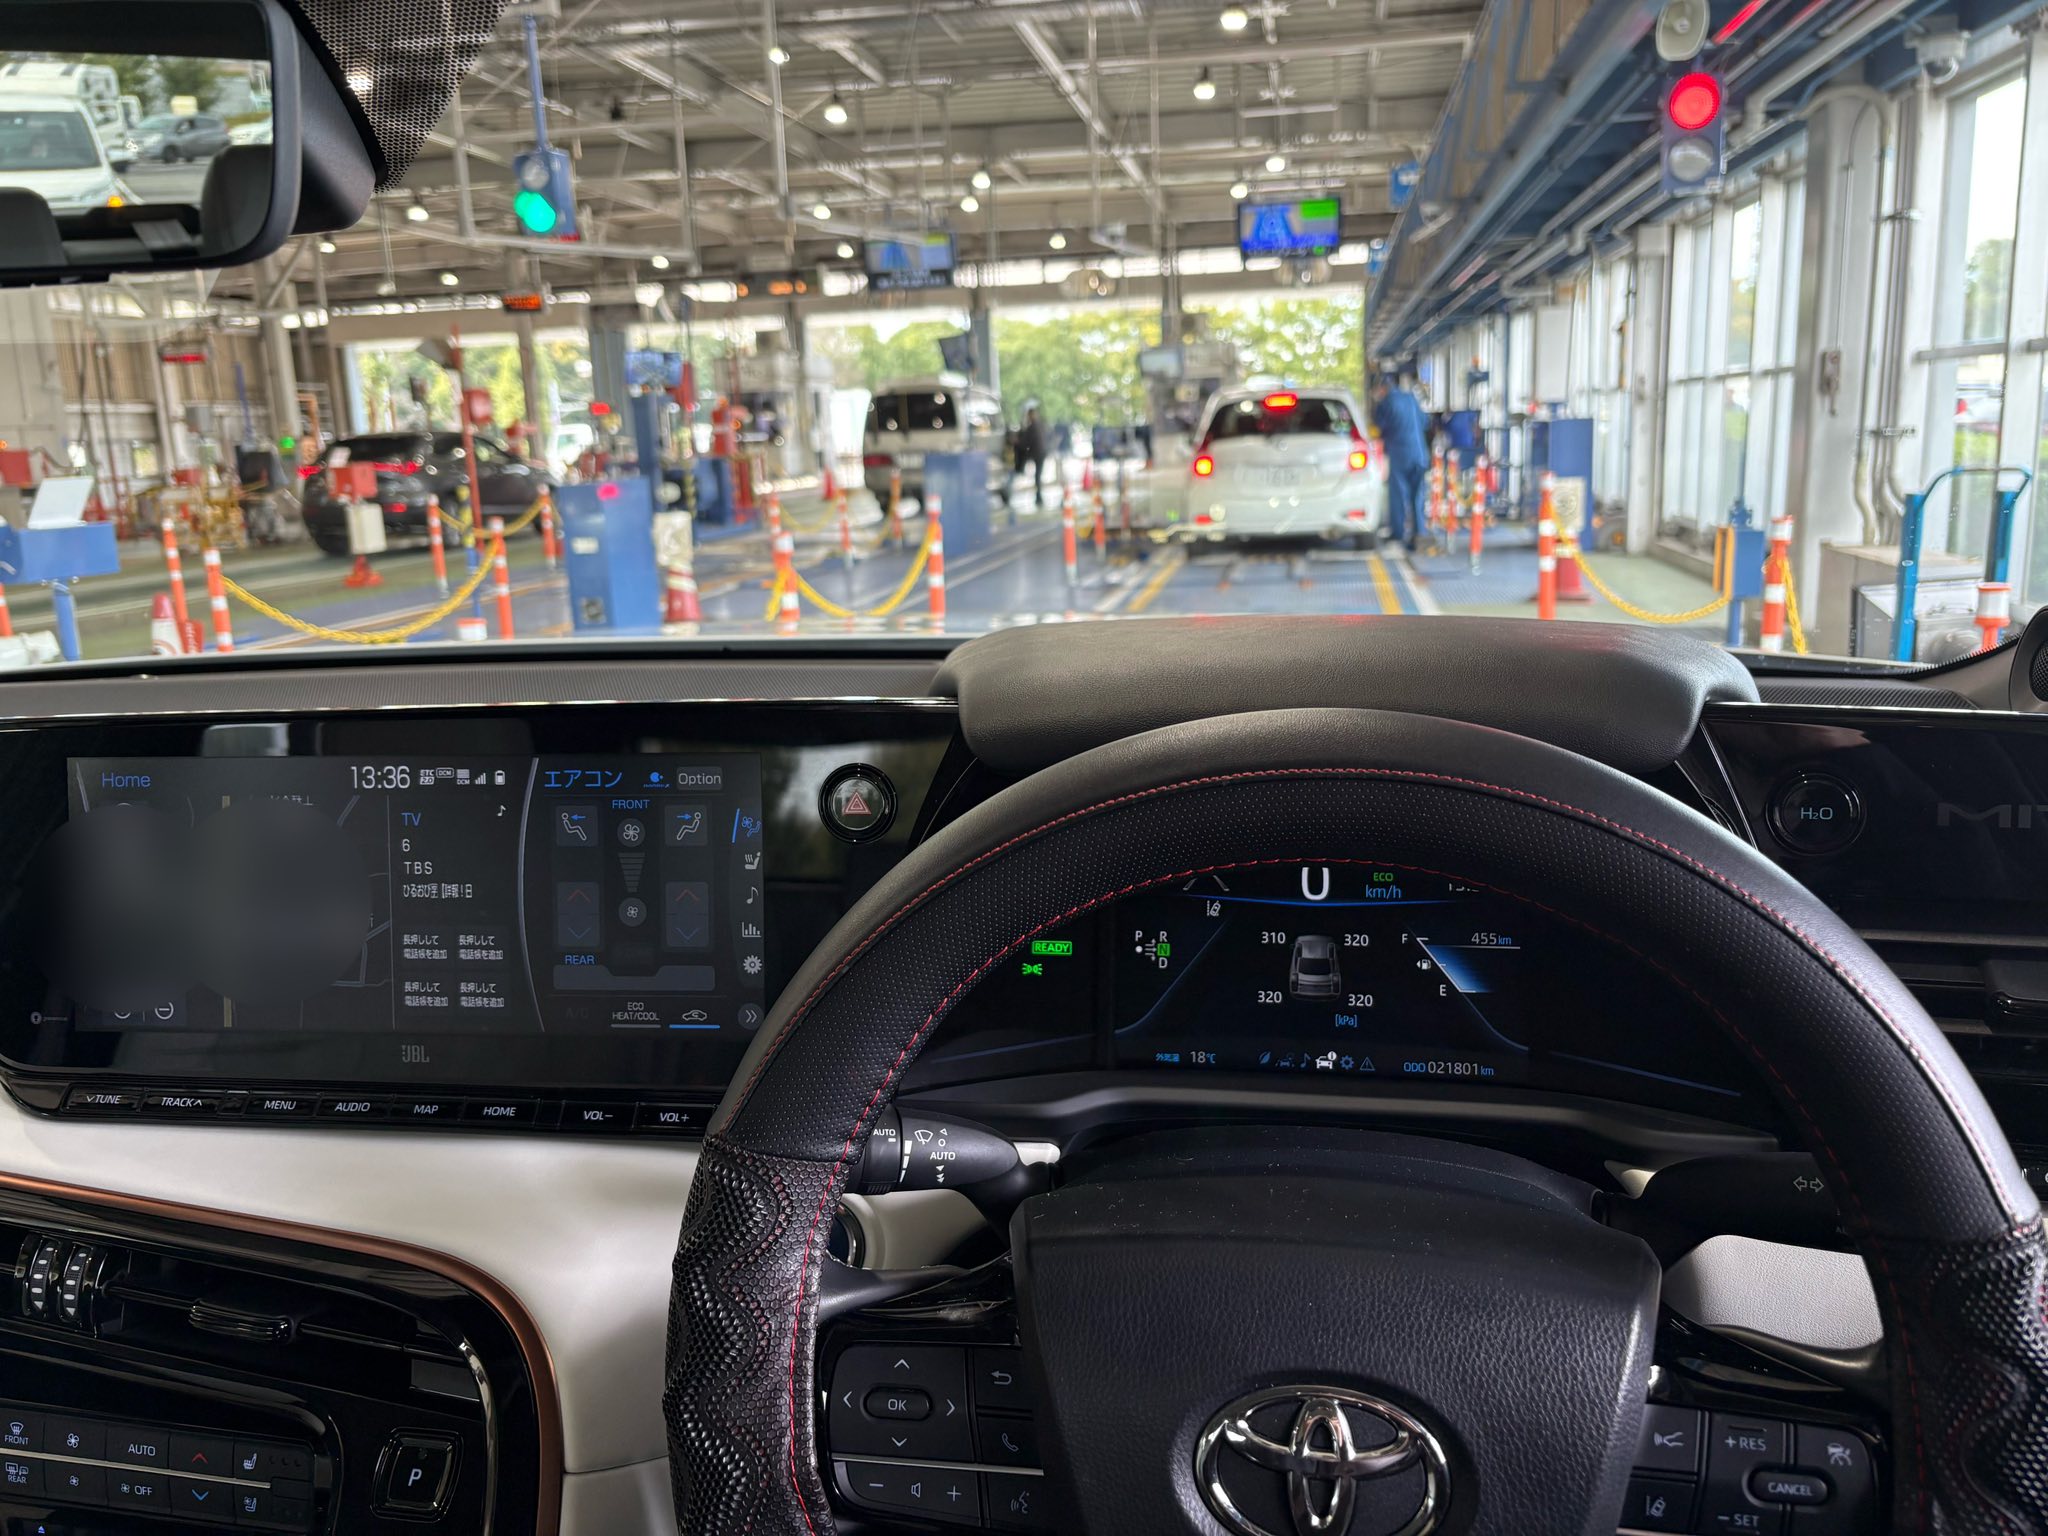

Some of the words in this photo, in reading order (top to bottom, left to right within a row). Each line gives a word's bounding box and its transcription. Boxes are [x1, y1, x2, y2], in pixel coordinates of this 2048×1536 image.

[102, 772, 151, 788] Home
[350, 766, 411, 789] 13:36
[420, 777, 434, 785] 2.0
[544, 770, 623, 789] エアコン
[678, 771, 721, 787] Option
[611, 799, 650, 810] FRONT
[401, 813, 422, 827] TV
[402, 838, 411, 852] 6
[404, 861, 433, 875] TBS
[1373, 872, 1394, 882] ECO
[1365, 884, 1402, 899] km/h
[403, 934, 439, 945] 長押しして
[459, 934, 496, 945] 長押しして
[1135, 931, 1143, 941] P
[1159, 931, 1168, 942] R
[1261, 932, 1286, 944] 310
[1343, 934, 1369, 946] 320
[1402, 933, 1408, 944] F
[1034, 942, 1069, 953] READY
[1160, 945, 1168, 955] N
[403, 948, 448, 959] 電話帳を追加
[459, 949, 504, 960] 電話帳を追加
[565, 955, 595, 965] REAR
[1159, 958, 1168, 968] D
[404, 981, 440, 993] 長押しして
[460, 982, 497, 993] 長押しして
[1439, 985, 1447, 996] E
[404, 996, 449, 1007] 電話帳を追加
[460, 996, 505, 1007] 電話帳を追加
[1257, 991, 1282, 1003] 320
[1347, 994, 1373, 1007] 320
[627, 1002, 644, 1012] ECO
[611, 1011, 660, 1021] HEAT/COOL
[401, 1045, 430, 1063] JBL
[1403, 1062, 1426, 1073] ODO
[95, 1094, 122, 1105] TUNE
[161, 1097, 193, 1108] TRACK
[264, 1101, 297, 1111] MENU
[335, 1102, 371, 1112] AUDIO
[413, 1105, 439, 1115] MAP
[483, 1106, 517, 1117] HOME
[873, 1128, 896, 1136] AUTO
[930, 1152, 956, 1161] AUTO
[888, 1399, 907, 1412] OK
[4, 1433, 30, 1446] FRONT
[128, 1443, 156, 1457] AUTO
[7, 1474, 27, 1484] REAR
[408, 1468, 423, 1487] P
[134, 1485, 153, 1496] OFF
[1767, 1481, 1813, 1497] CANCEL
